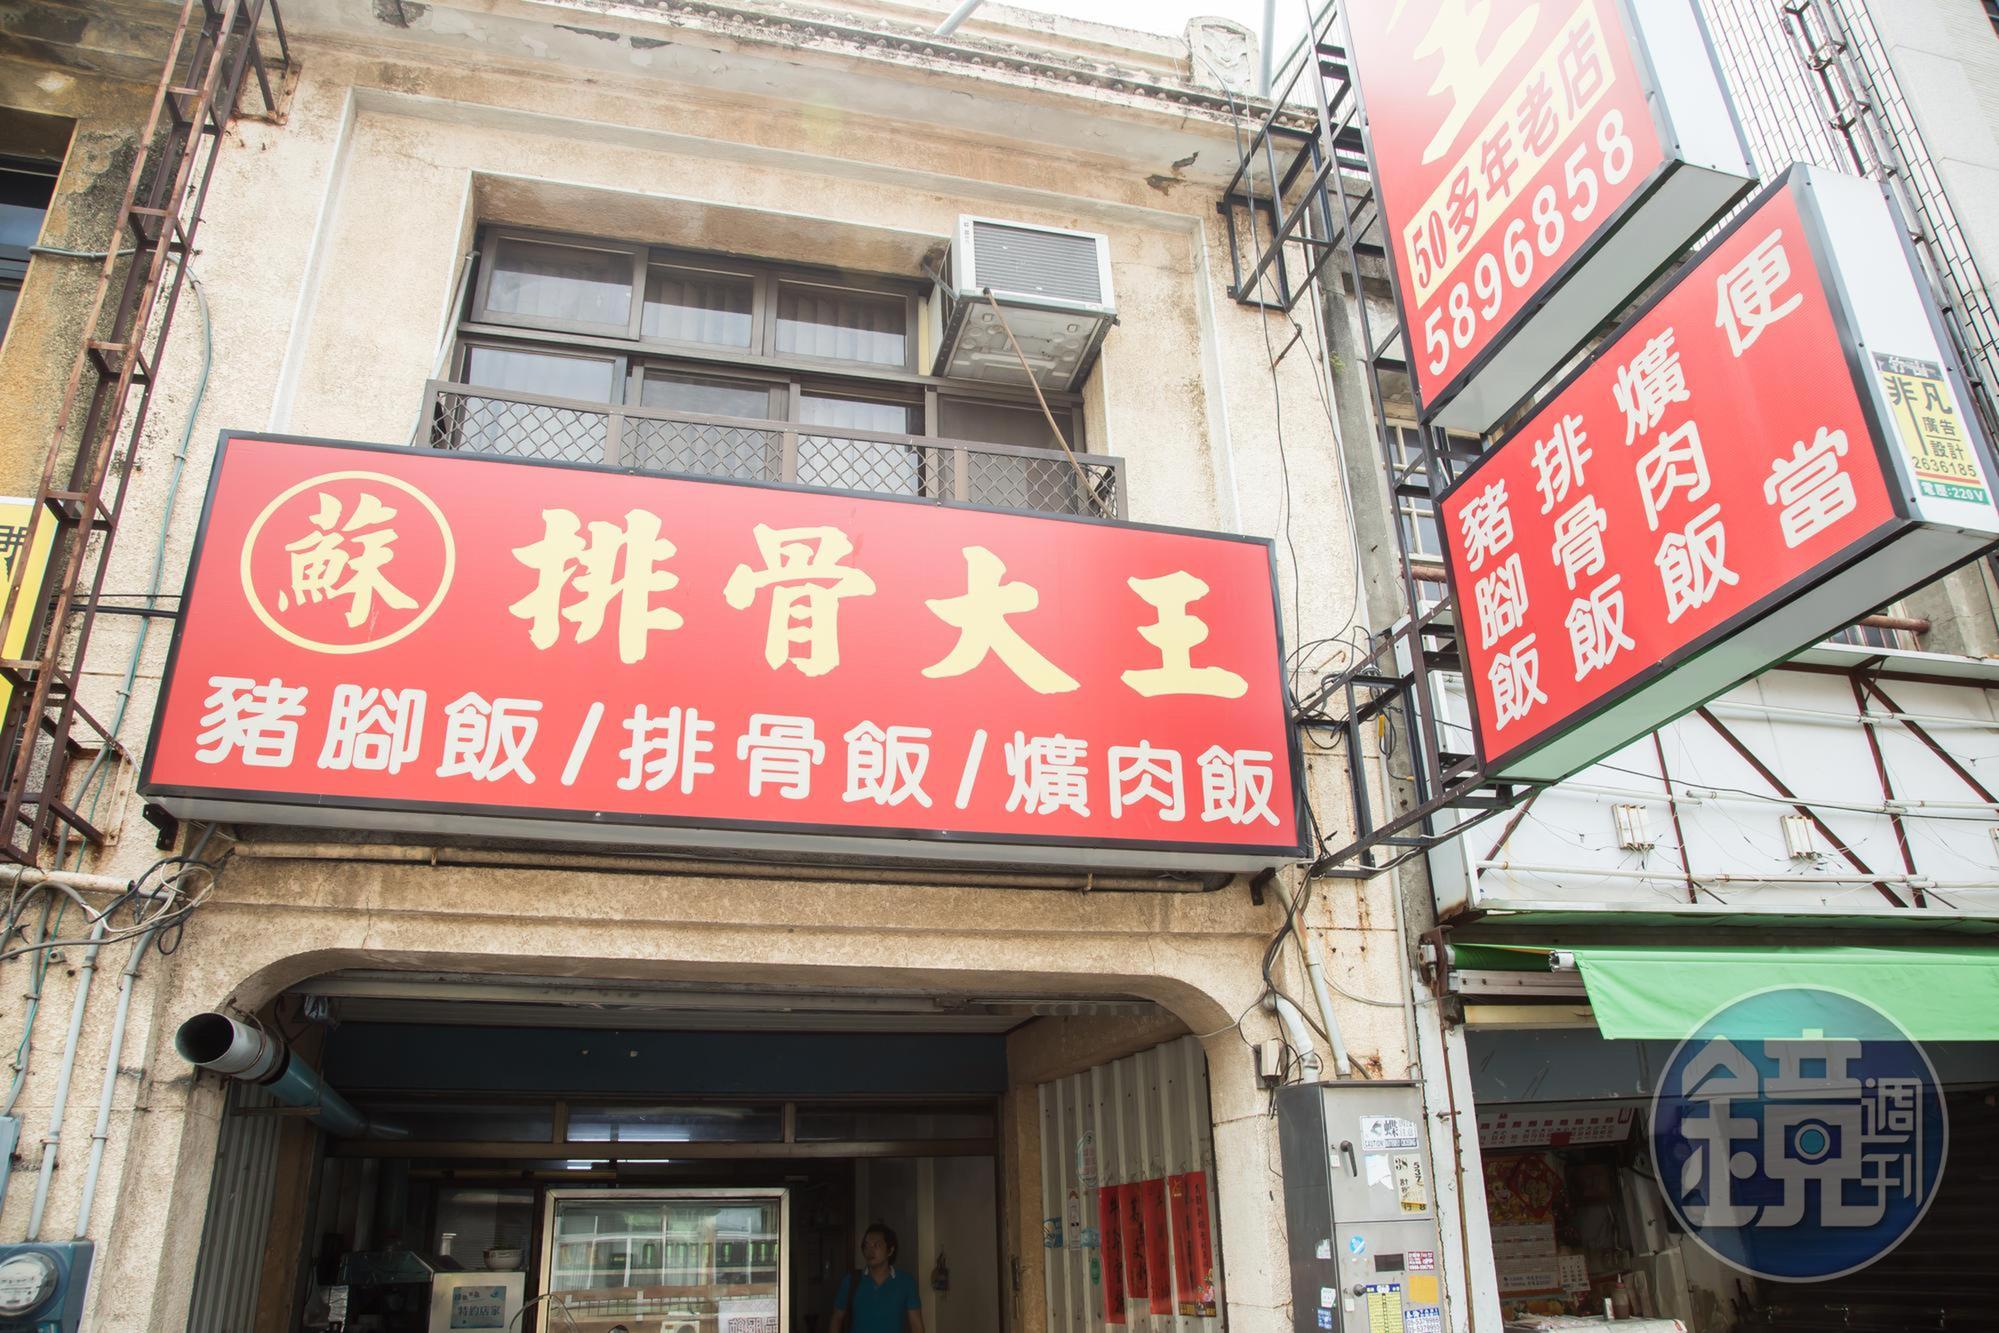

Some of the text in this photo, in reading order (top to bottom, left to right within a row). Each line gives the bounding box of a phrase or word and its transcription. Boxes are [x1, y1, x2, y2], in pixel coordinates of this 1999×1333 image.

[1410, 18, 1605, 289] 50多年老店
[1425, 108, 1634, 377] 5896858
[1611, 326, 1740, 625] 爌肉飯
[1715, 228, 1858, 549] 便當
[1911, 456, 1977, 478] 2636185
[1922, 416, 1956, 436] 廣告
[1930, 440, 1964, 461] 設計
[278, 492, 419, 629] 蘇
[508, 507, 1249, 699] 排骨大王
[1458, 477, 1548, 732] 豬腳飯
[1530, 413, 1636, 683] 排骨飯
